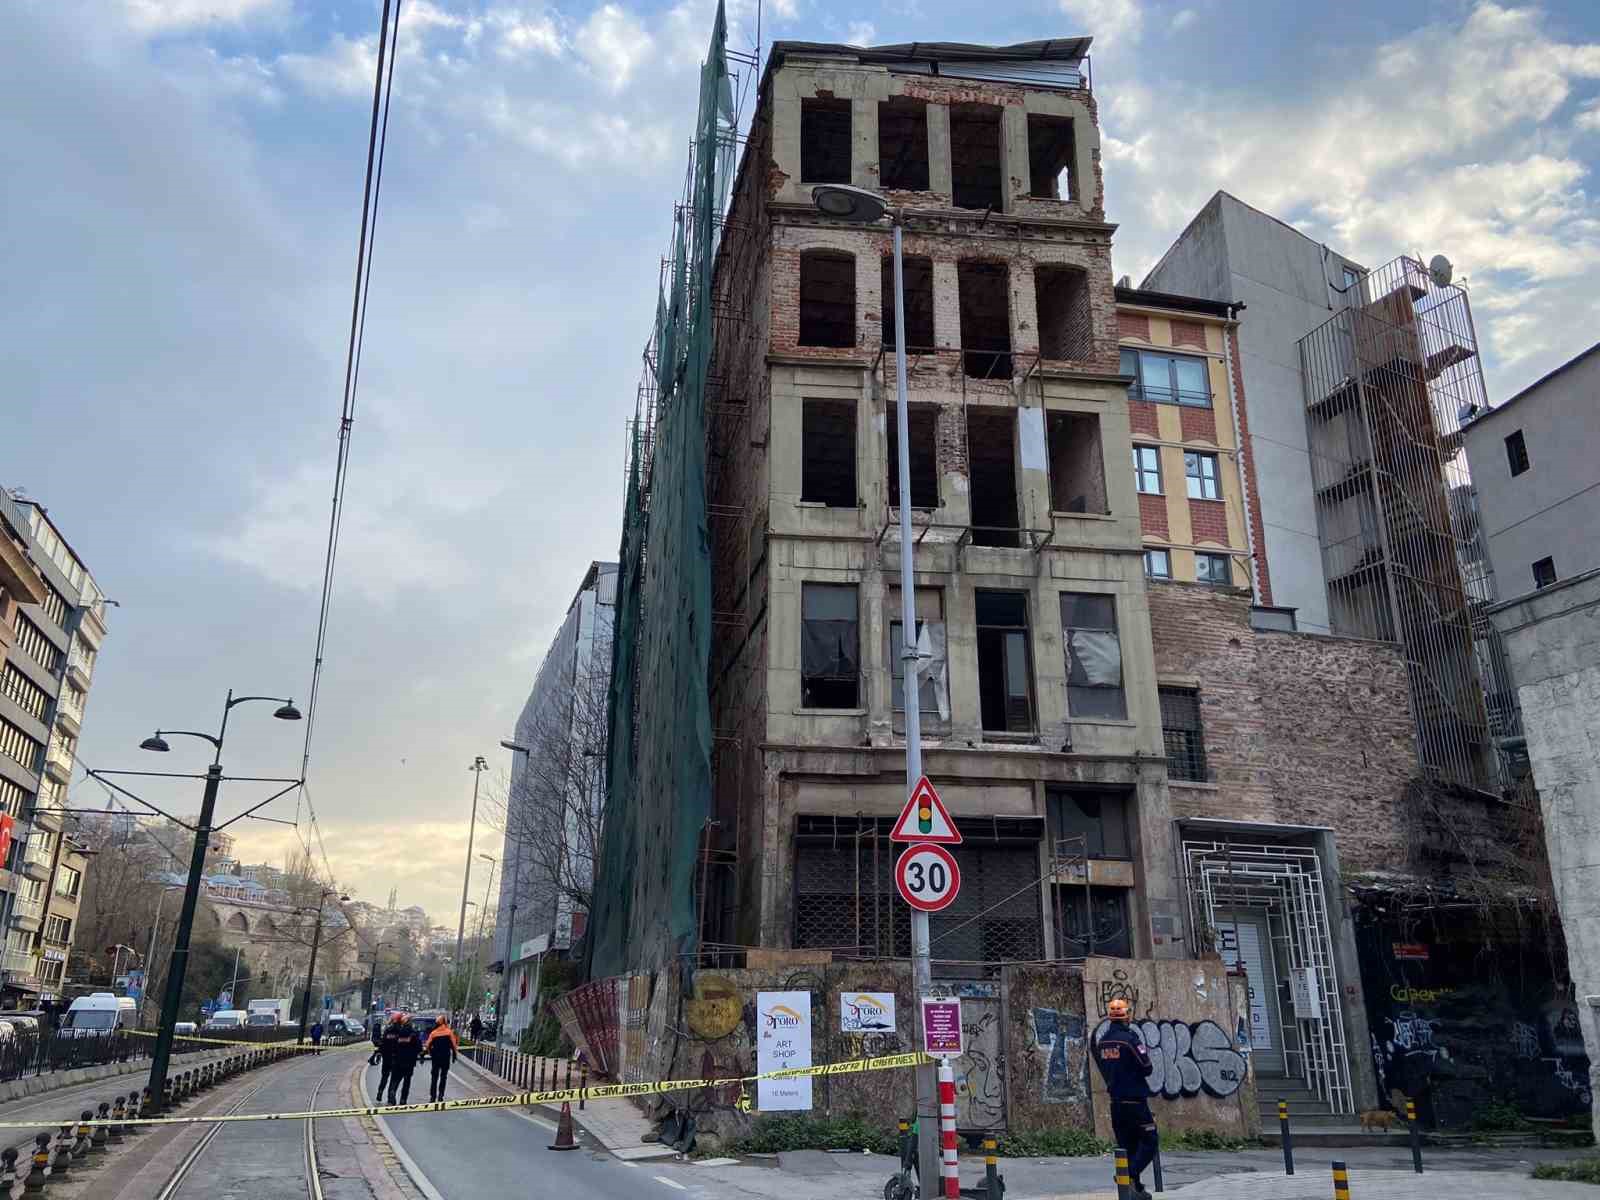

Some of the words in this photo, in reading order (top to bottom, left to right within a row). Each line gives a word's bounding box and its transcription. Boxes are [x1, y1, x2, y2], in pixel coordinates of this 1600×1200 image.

[908, 862, 945, 893] 30
[776, 1040, 792, 1048] ART
[773, 1050, 797, 1058] SHOP
